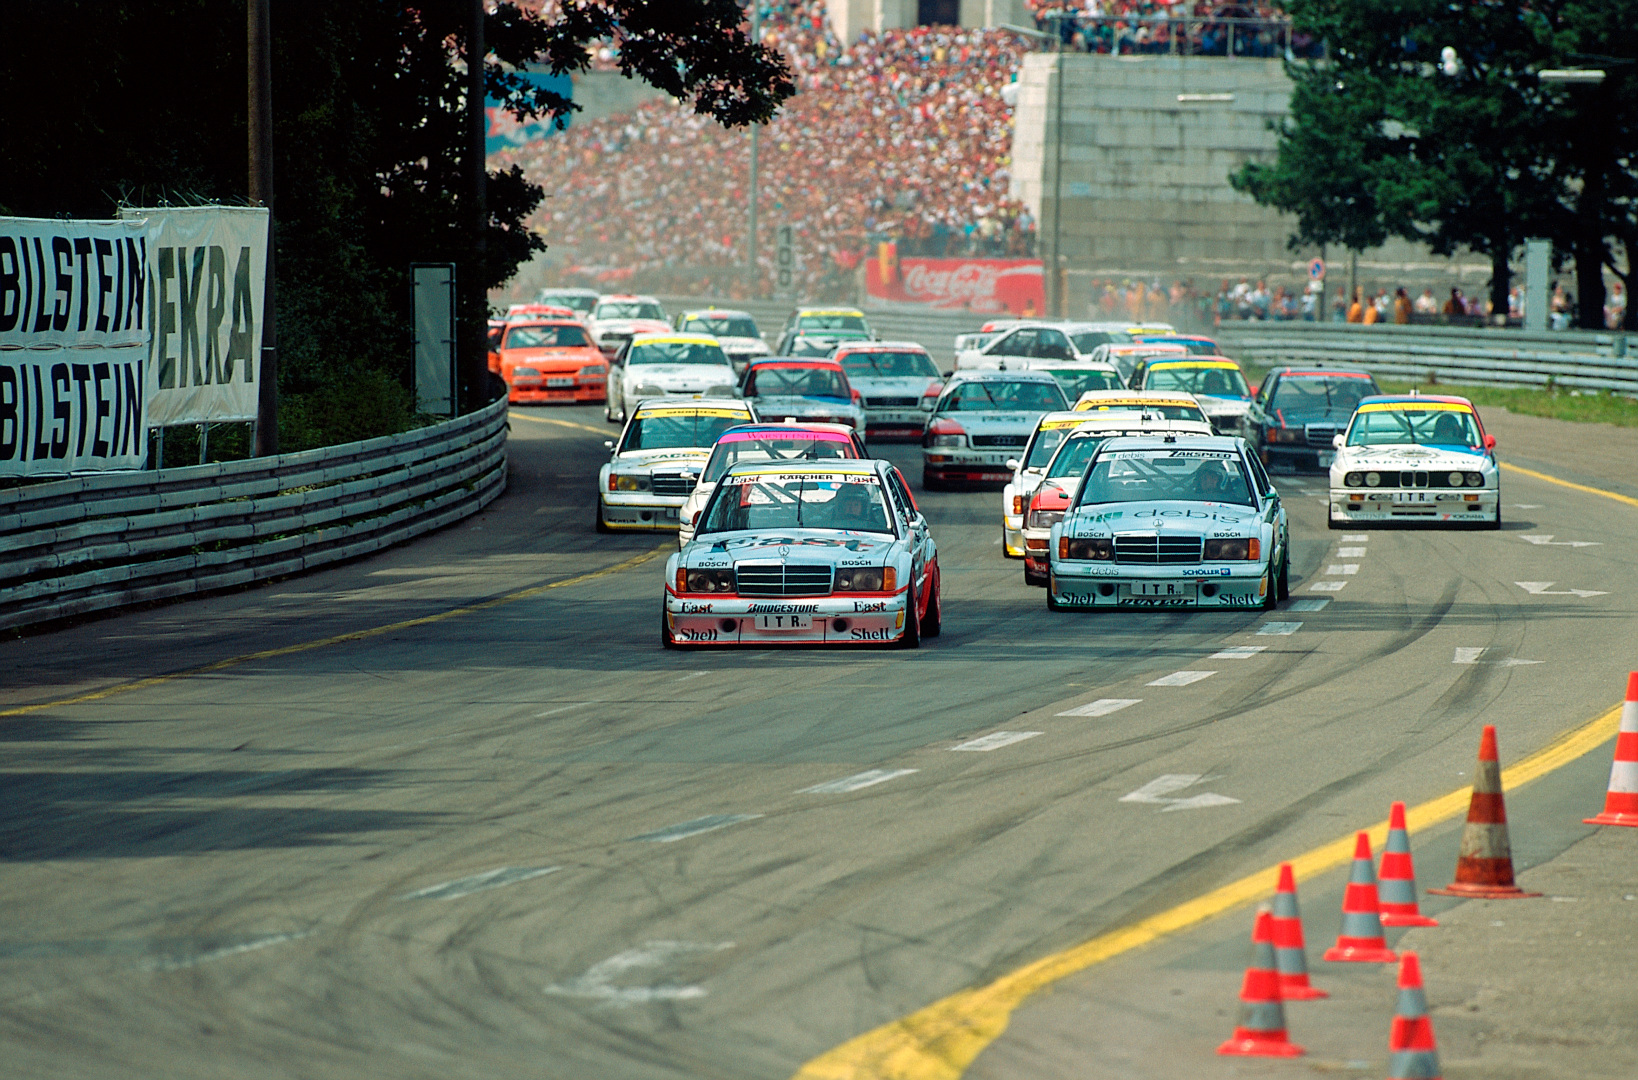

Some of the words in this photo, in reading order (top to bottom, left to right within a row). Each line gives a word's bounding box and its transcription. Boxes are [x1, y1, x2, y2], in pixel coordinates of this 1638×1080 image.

[0, 236, 146, 333] BILSTEIN
[0, 359, 143, 462] BILSTEIN
[747, 432, 820, 440] WARSTEINER
[1071, 430, 1122, 438] Audi
[1118, 451, 1145, 459] debis
[1168, 450, 1232, 459] ZAKSPEED
[732, 476, 762, 486] East
[845, 474, 876, 485] East
[1134, 509, 1240, 524] debis
[1091, 566, 1120, 576] debis
[1182, 568, 1220, 576] SCHÖLLER
[1061, 591, 1096, 604] Shell
[1219, 593, 1257, 605] Shell
[680, 602, 713, 614] East
[747, 603, 820, 613] BRIDGESTONE
[853, 601, 887, 613] East
[680, 627, 718, 640] Shell
[850, 627, 890, 640] Shell
